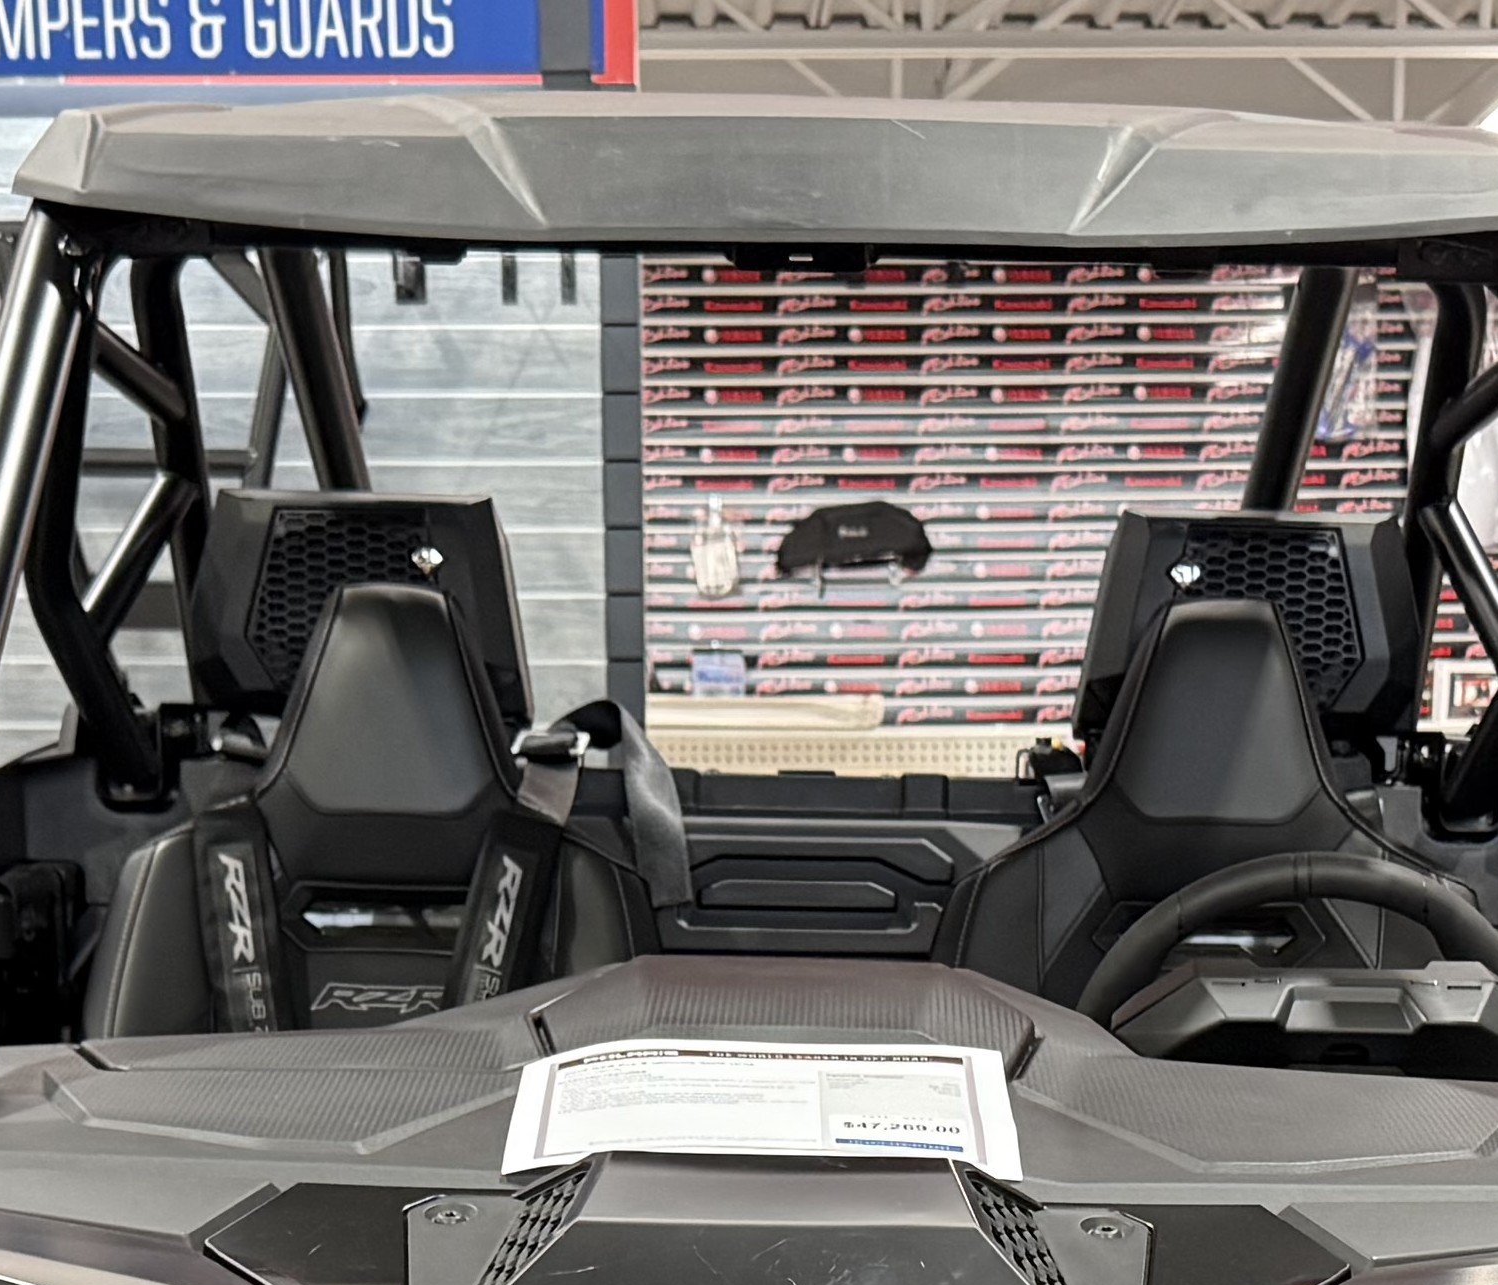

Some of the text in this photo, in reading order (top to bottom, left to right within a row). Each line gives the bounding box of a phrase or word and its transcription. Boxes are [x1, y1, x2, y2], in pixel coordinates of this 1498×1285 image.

[191, 0, 226, 60] &
[244, 0, 455, 60] GUARDS
[218, 853, 255, 963] RZR
[482, 854, 523, 968] RZR
